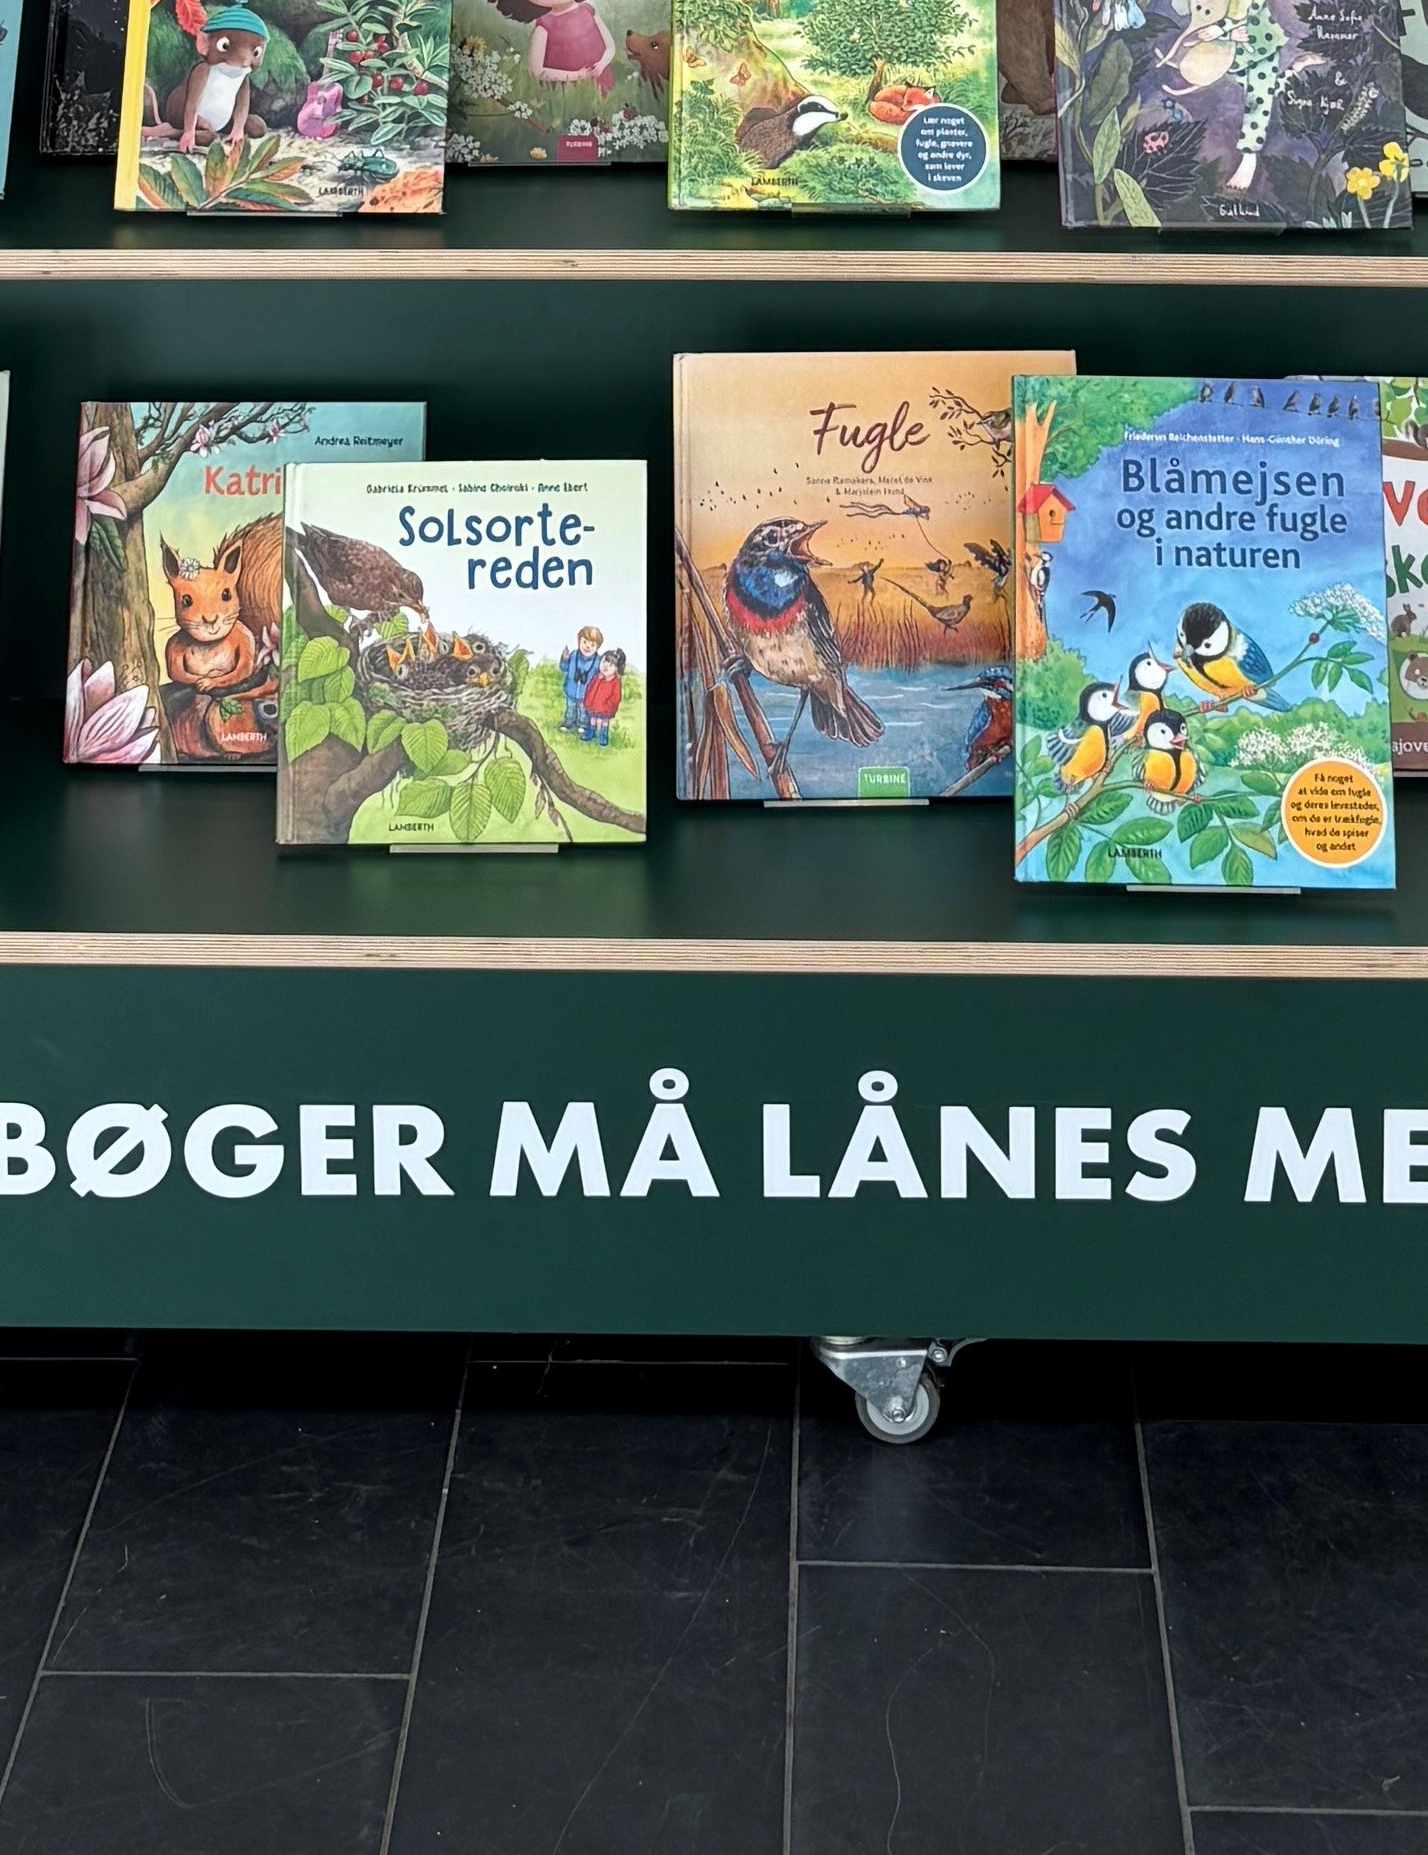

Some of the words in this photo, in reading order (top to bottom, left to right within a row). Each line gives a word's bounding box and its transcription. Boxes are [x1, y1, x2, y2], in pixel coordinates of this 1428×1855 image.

[314, 435, 351, 447] Andrea
[353, 436, 403, 448] Reitmeyer
[809, 401, 930, 473] Fugle
[204, 465, 283, 496] Katri
[1122, 457, 1345, 506] Blåmejsen
[399, 502, 595, 547] Solsorte-
[1117, 507, 1155, 537] og
[1165, 501, 1255, 532] andre
[1266, 503, 1348, 541] fugle
[468, 546, 593, 590] reden
[1155, 538, 1164, 566] i
[1175, 542, 1300, 569] naturen
[221, 731, 267, 743] LAMBERTH
[864, 773, 906, 784] TURBINE
[388, 821, 434, 833] LAMBERTH
[490, 1068, 719, 1196] MÅ
[763, 1071, 1196, 1201] LÅNES
